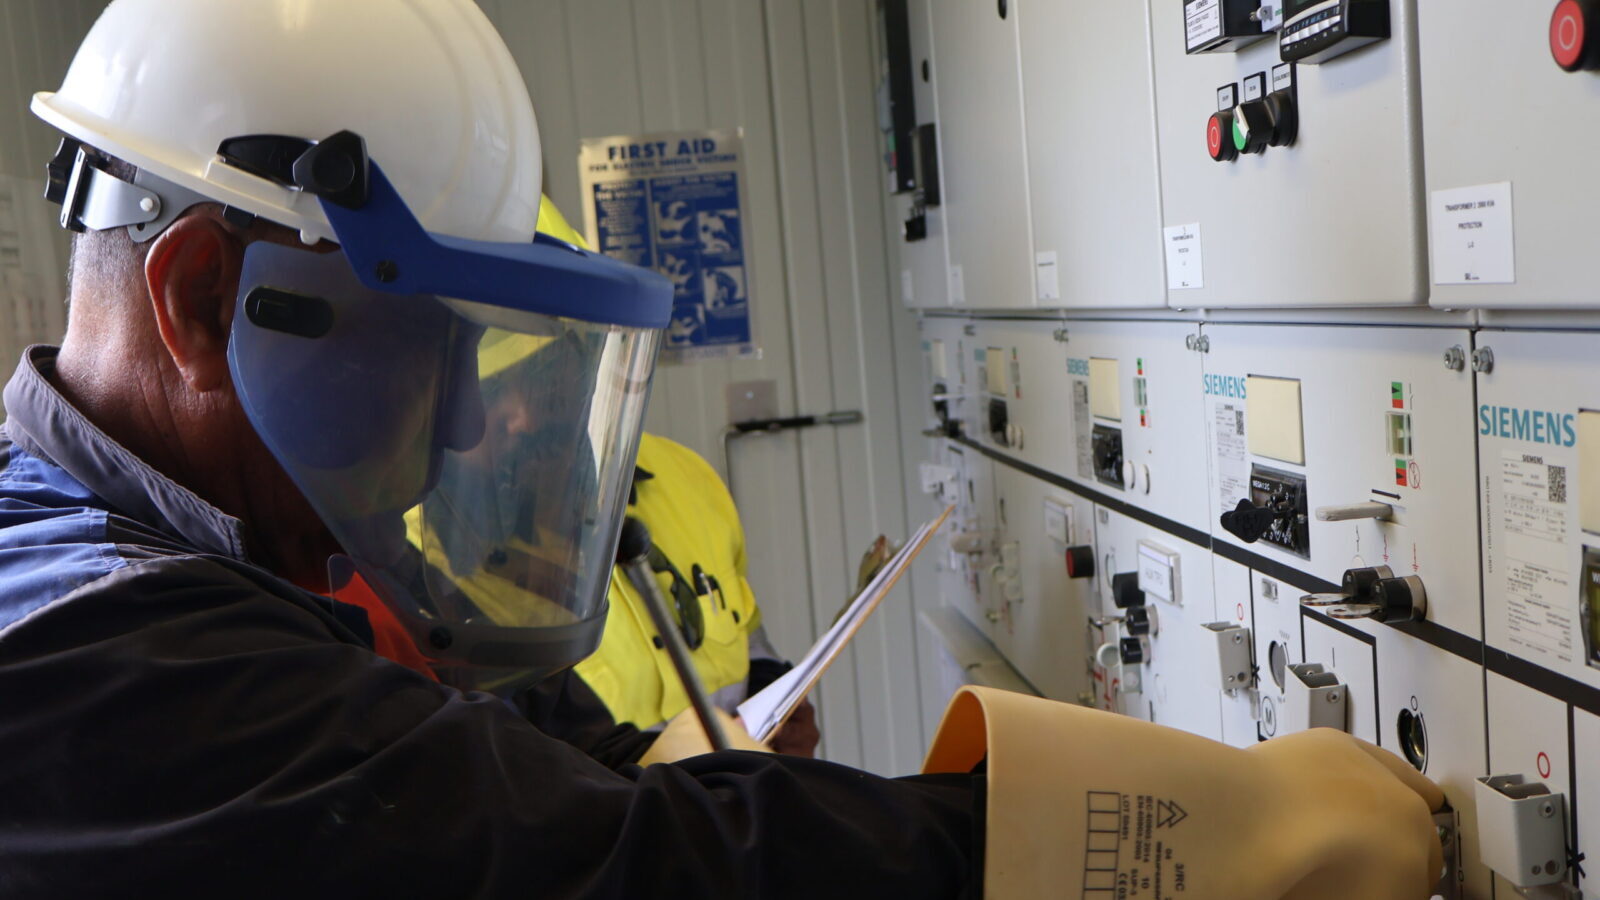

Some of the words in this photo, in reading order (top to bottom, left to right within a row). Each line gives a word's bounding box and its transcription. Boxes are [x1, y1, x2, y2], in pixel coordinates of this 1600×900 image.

[608, 143, 666, 159] FIRST
[678, 139, 715, 154] AID
[1066, 358, 1089, 376] SIEMENS
[1204, 373, 1247, 400] SIEMENS
[1479, 404, 1576, 448] SIEMENS
[1522, 454, 1544, 464] SIEMENS
[1145, 795, 1153, 811] IEC
[1175, 863, 1184, 891] 3/RC
